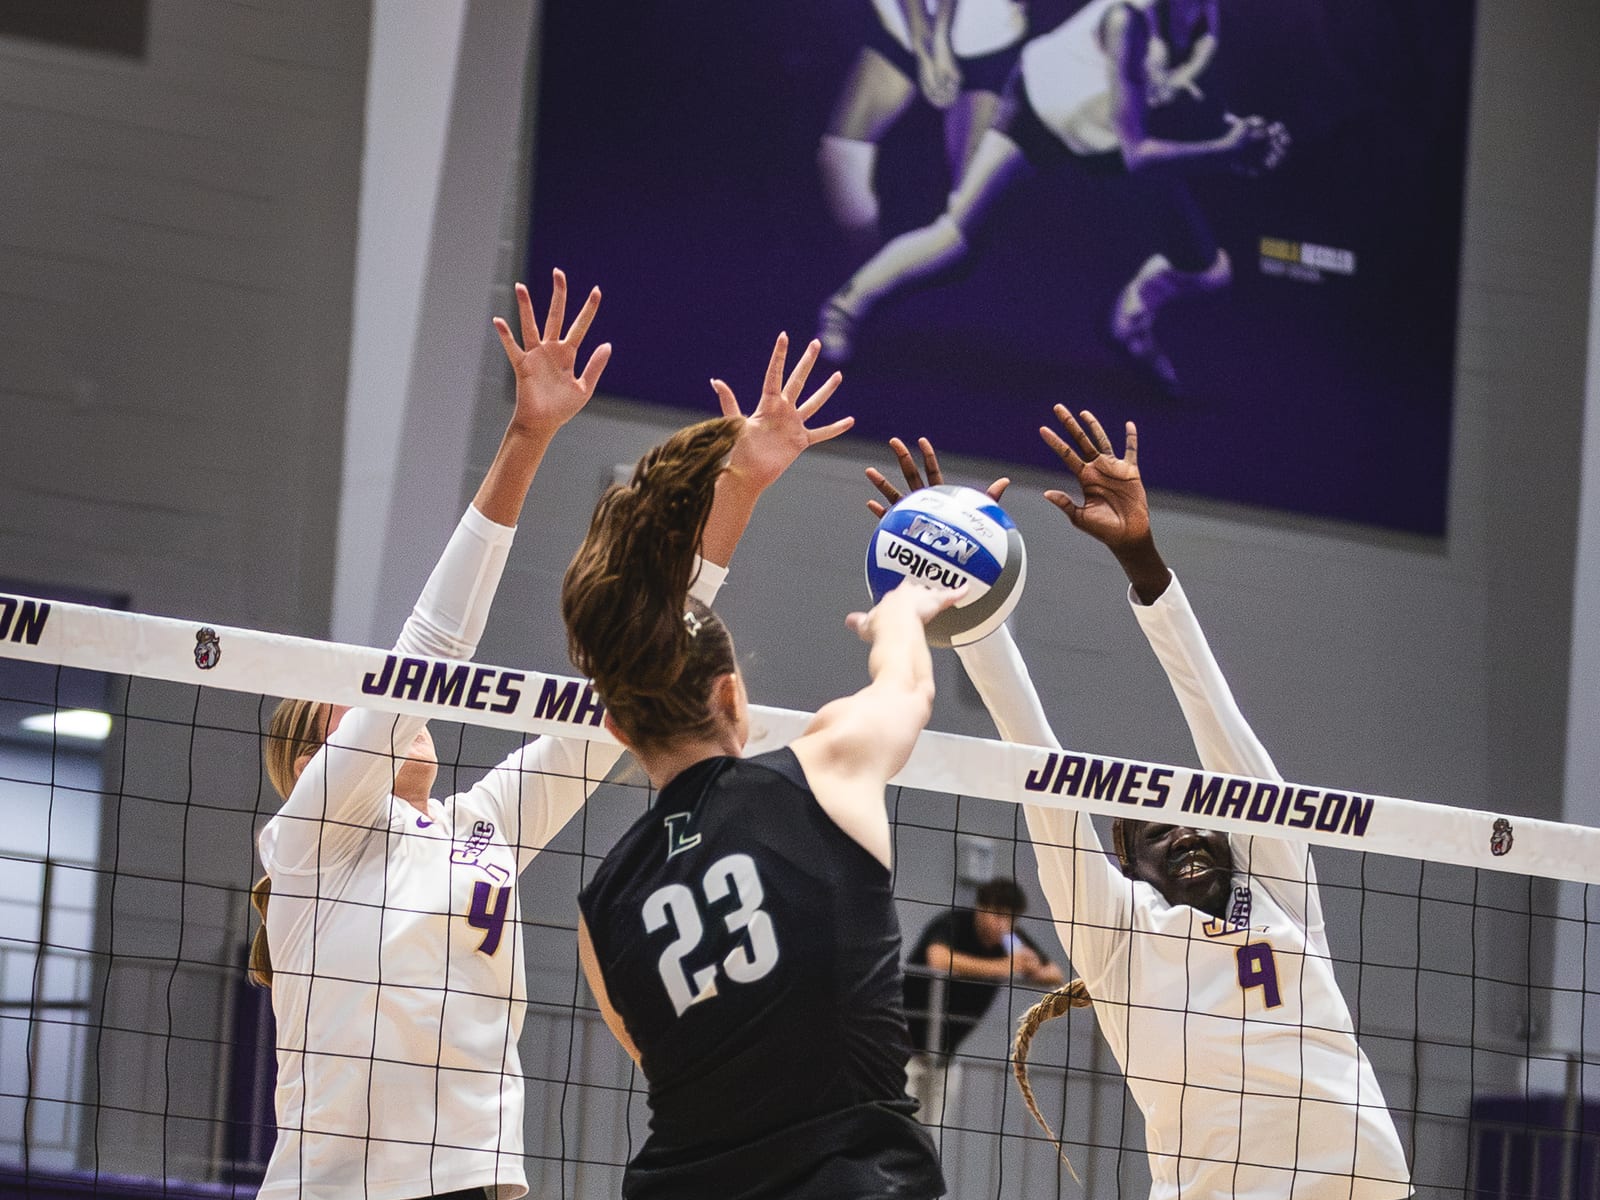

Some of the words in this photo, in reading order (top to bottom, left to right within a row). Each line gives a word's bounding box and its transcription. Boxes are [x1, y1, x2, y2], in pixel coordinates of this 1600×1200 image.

[887, 541, 968, 590] molten
[903, 515, 979, 566] NCAA
[361, 654, 526, 714] JAMES
[1025, 753, 1174, 809] JAMES
[1181, 773, 1375, 837] MADISON
[466, 880, 513, 957] 4
[641, 853, 780, 1018] 23
[1236, 942, 1282, 1009] 9
